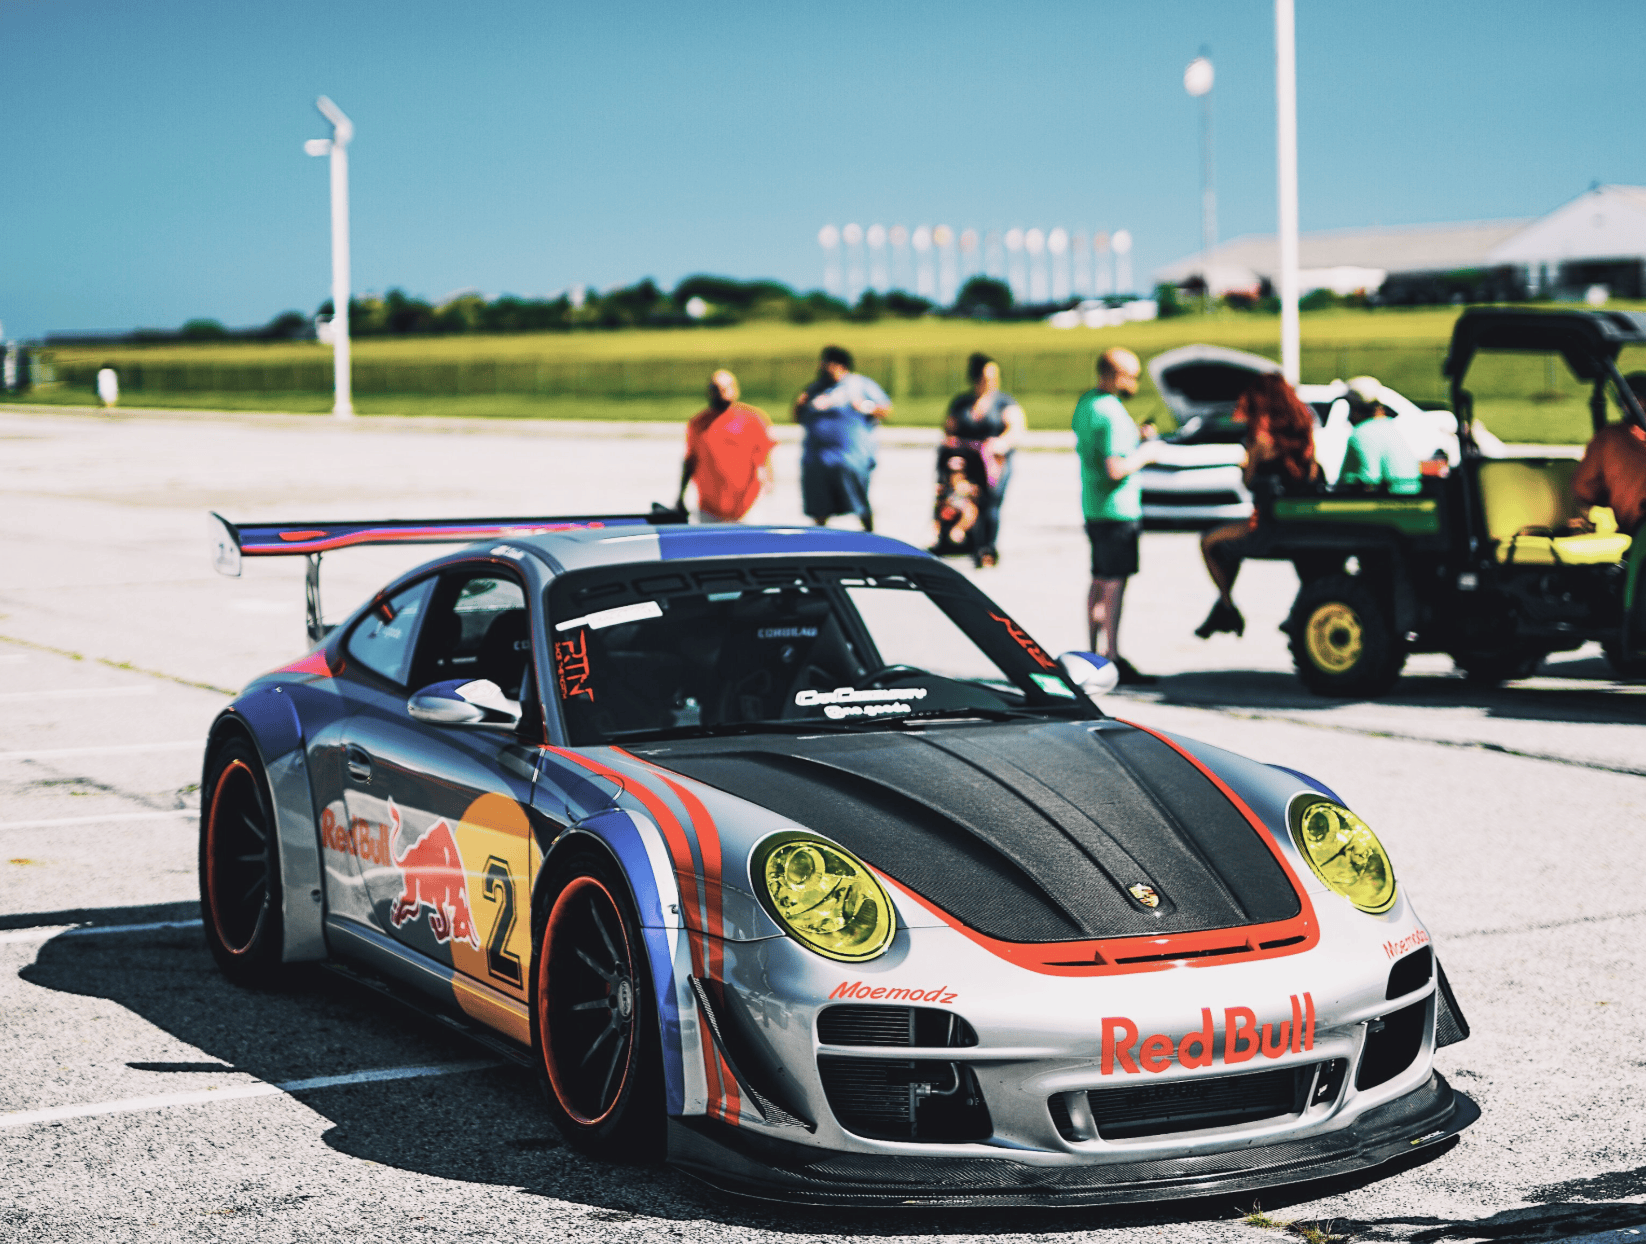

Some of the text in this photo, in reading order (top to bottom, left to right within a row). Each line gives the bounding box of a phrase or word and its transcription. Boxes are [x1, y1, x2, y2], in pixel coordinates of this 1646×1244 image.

[569, 566, 964, 606] PORSCHE
[321, 807, 391, 867] Red Bull
[482, 854, 523, 990] 2
[828, 981, 958, 1004] Moemodz
[1101, 992, 1315, 1075] Red Bull
